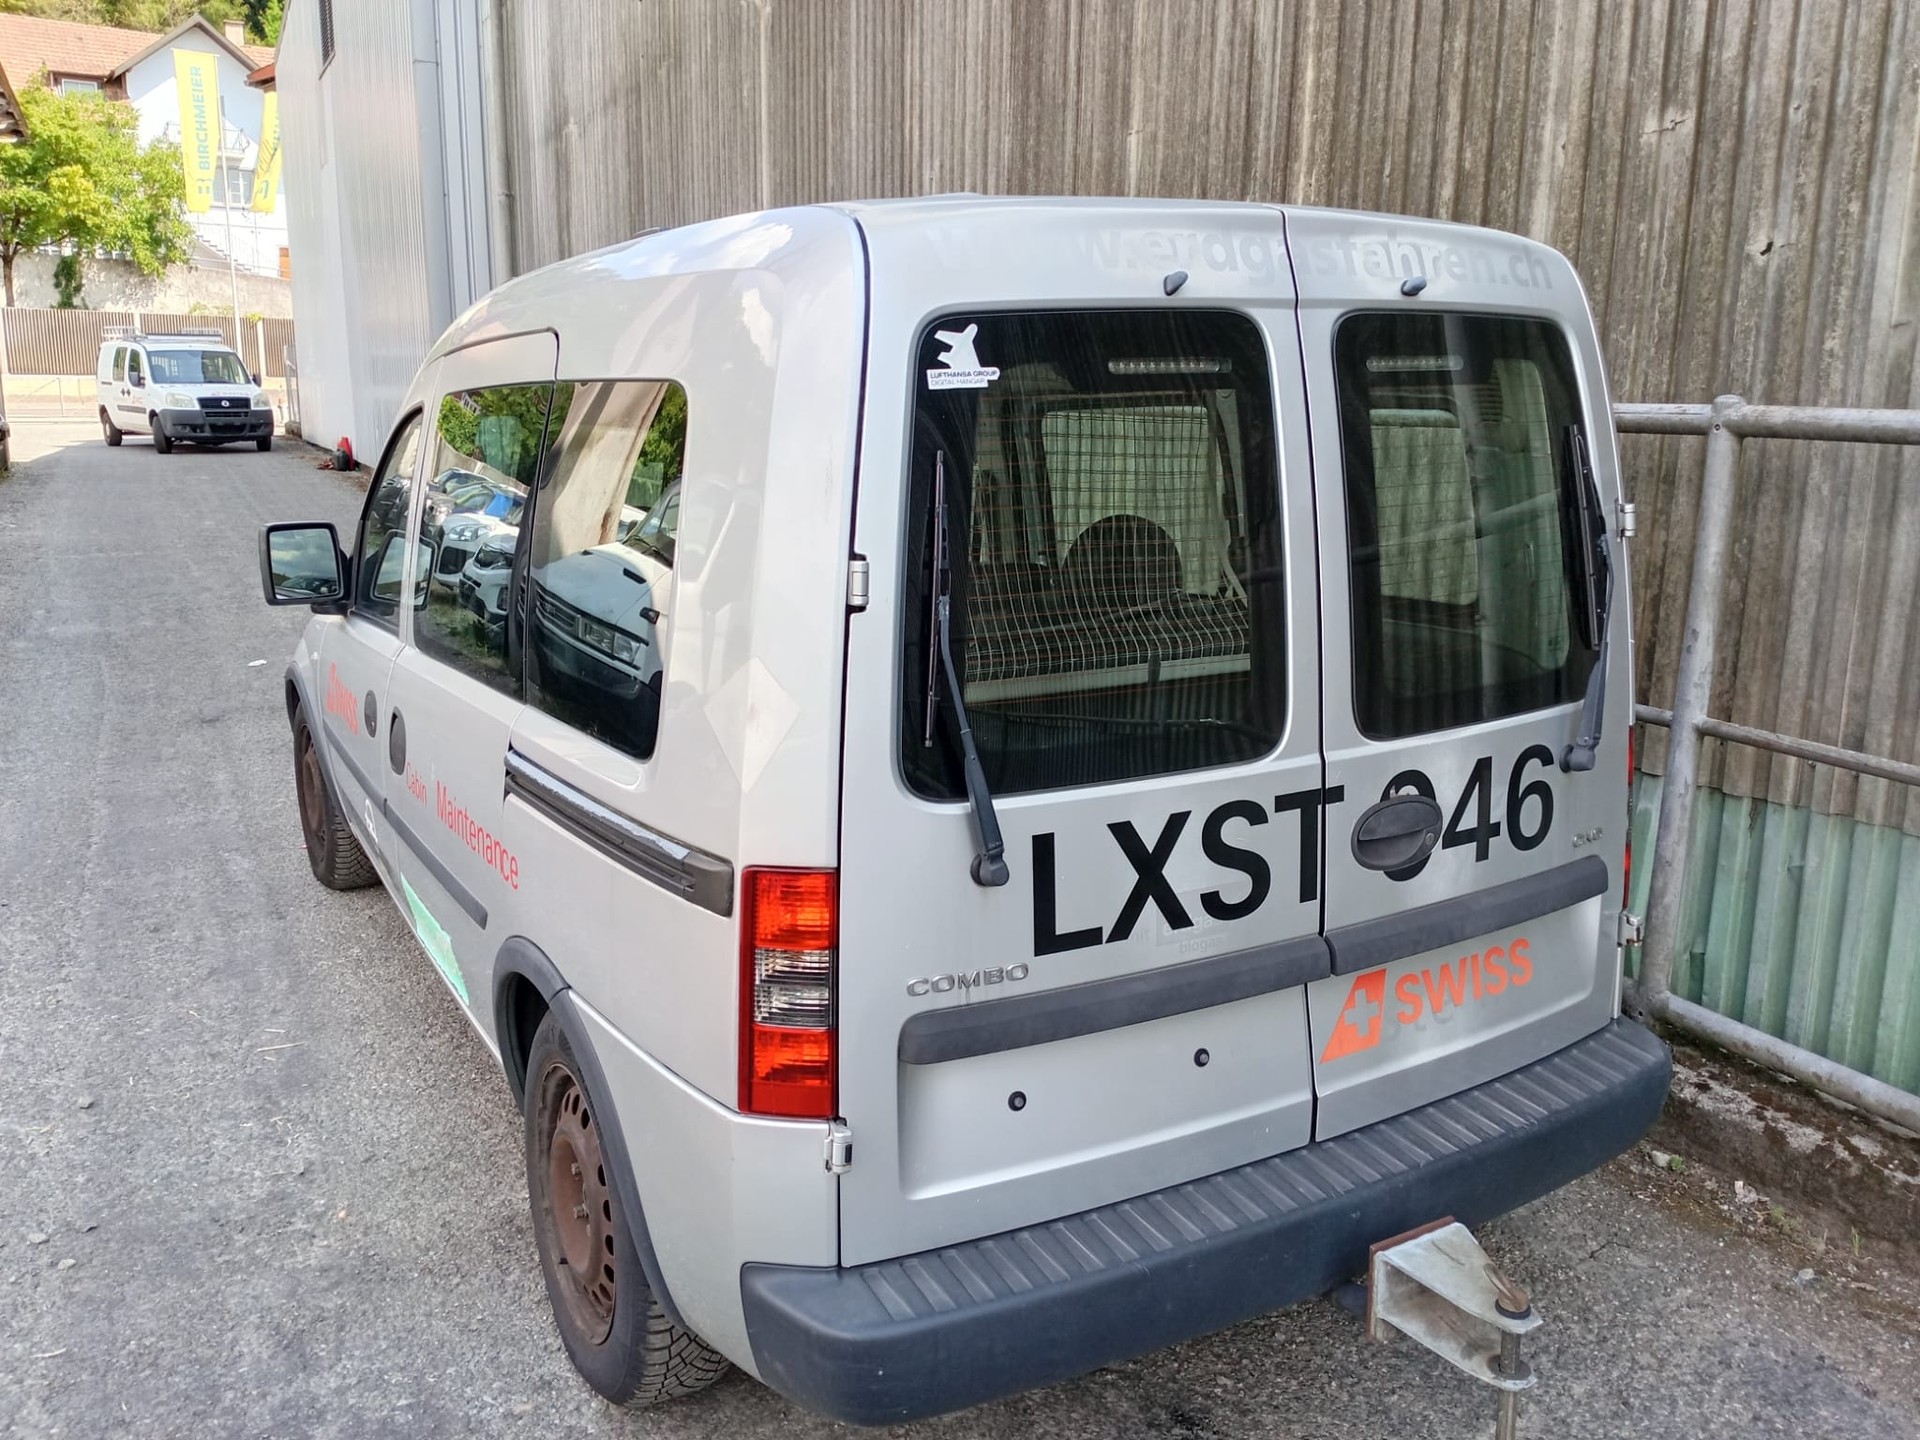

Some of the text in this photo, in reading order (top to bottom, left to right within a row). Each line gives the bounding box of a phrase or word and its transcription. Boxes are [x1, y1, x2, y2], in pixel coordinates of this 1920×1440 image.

[190, 66, 211, 170] BIRCHMEIER
[930, 369, 998, 379] LUFTHANSA GROUP
[406, 761, 427, 808] Cabin
[436, 779, 519, 891] Maintenance
[1032, 785, 1345, 957] LXST
[906, 962, 1030, 997] COMBO
[1395, 937, 1534, 1025] SWISS
